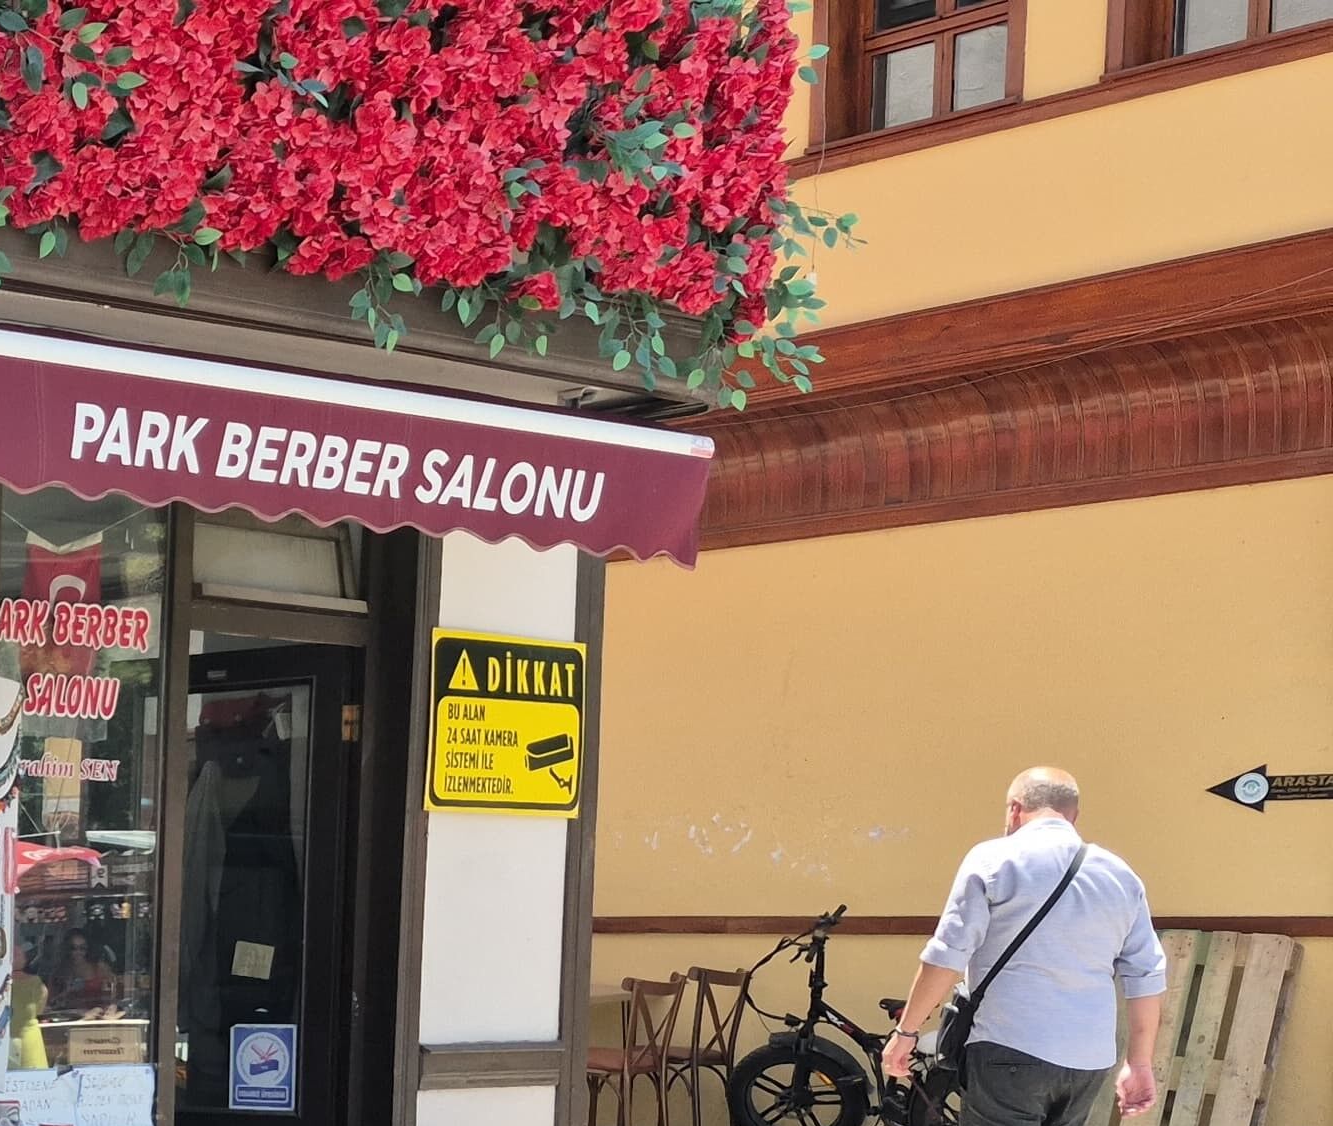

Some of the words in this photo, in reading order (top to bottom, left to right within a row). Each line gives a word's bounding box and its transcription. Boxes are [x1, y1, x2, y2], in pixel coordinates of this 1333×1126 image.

[70, 402, 209, 475] PARK
[215, 421, 410, 499] BERBER
[414, 448, 605, 522] SALONU
[53, 601, 150, 652] BERBER
[487, 651, 576, 698] DİKKAT
[23, 672, 121, 720] SALONU
[448, 703, 460, 720] BU
[462, 704, 486, 721] ALAN
[446, 727, 458, 744] 24
[460, 728, 482, 746] SAAT
[483, 729, 518, 747] KAMERA
[445, 750, 479, 769] SİSTEMİ
[481, 751, 494, 770] İLE
[444, 774, 514, 794] İZLENMEKTEDİR.
